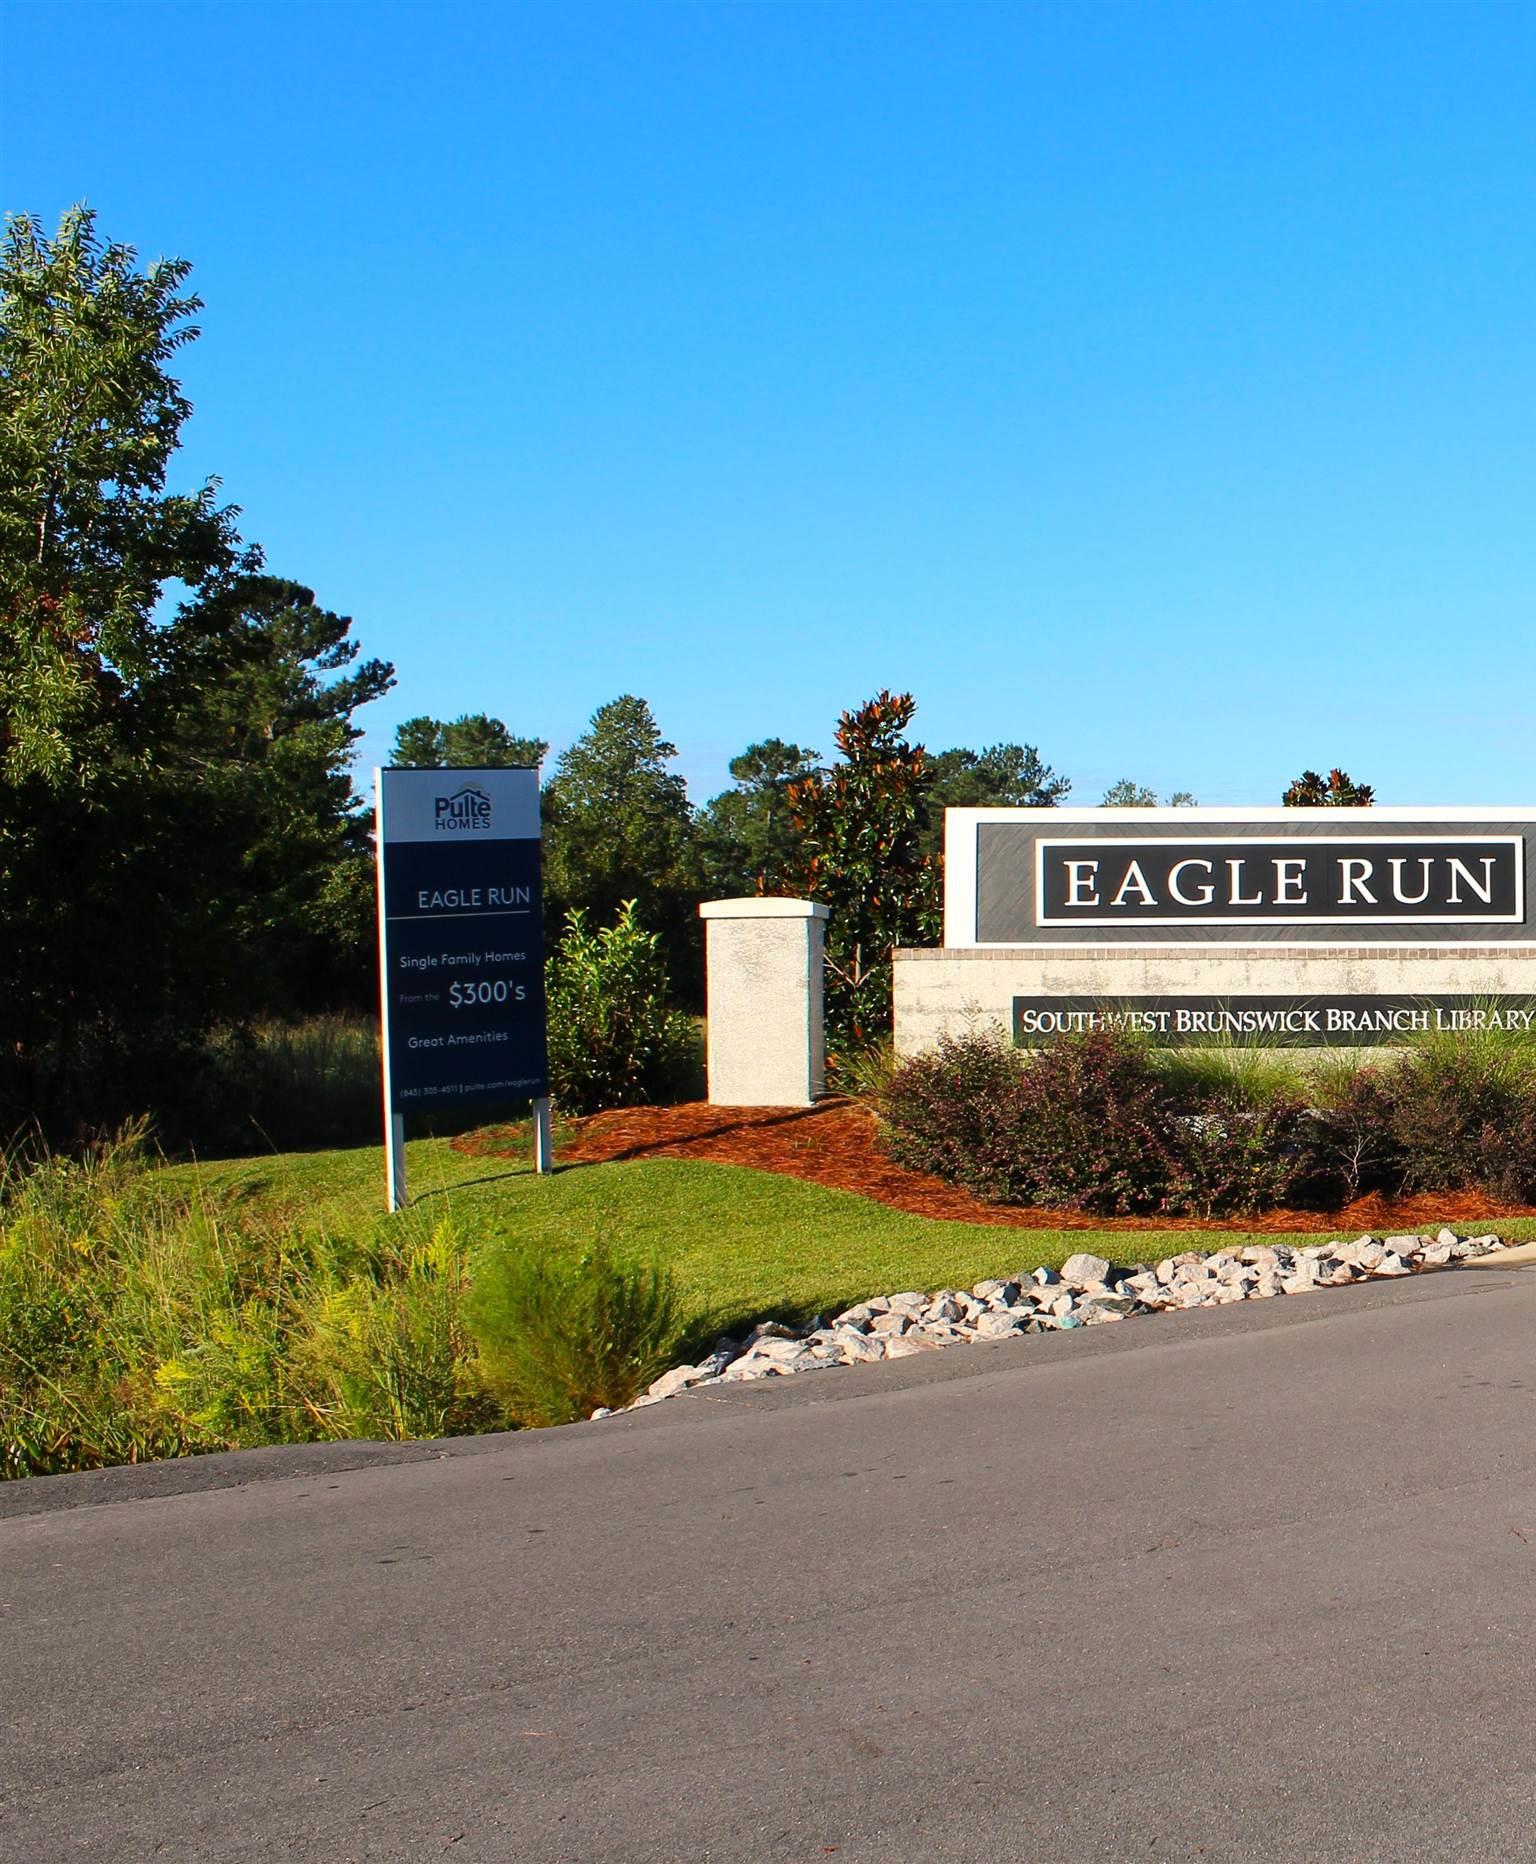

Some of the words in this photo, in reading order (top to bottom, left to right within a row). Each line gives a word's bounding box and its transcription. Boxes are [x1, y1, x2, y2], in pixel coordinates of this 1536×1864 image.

[435, 795, 491, 818] Pulte
[435, 818, 491, 830] HOMES
[1063, 858, 1308, 906] EAGLE
[1337, 857, 1497, 905] RUN
[418, 888, 481, 909] EAGLE
[488, 886, 530, 905] RUN
[400, 955, 438, 970] Single
[442, 953, 481, 966] Family
[485, 951, 526, 963] Homes
[450, 980, 526, 1008] $300's
[1175, 1008, 1321, 1033] BRUNSWICK
[1326, 1008, 1430, 1032] BRANCH
[1435, 1008, 1536, 1032] LIBRARY
[408, 1036, 444, 1049] Great
[447, 1031, 508, 1045] Amenities
